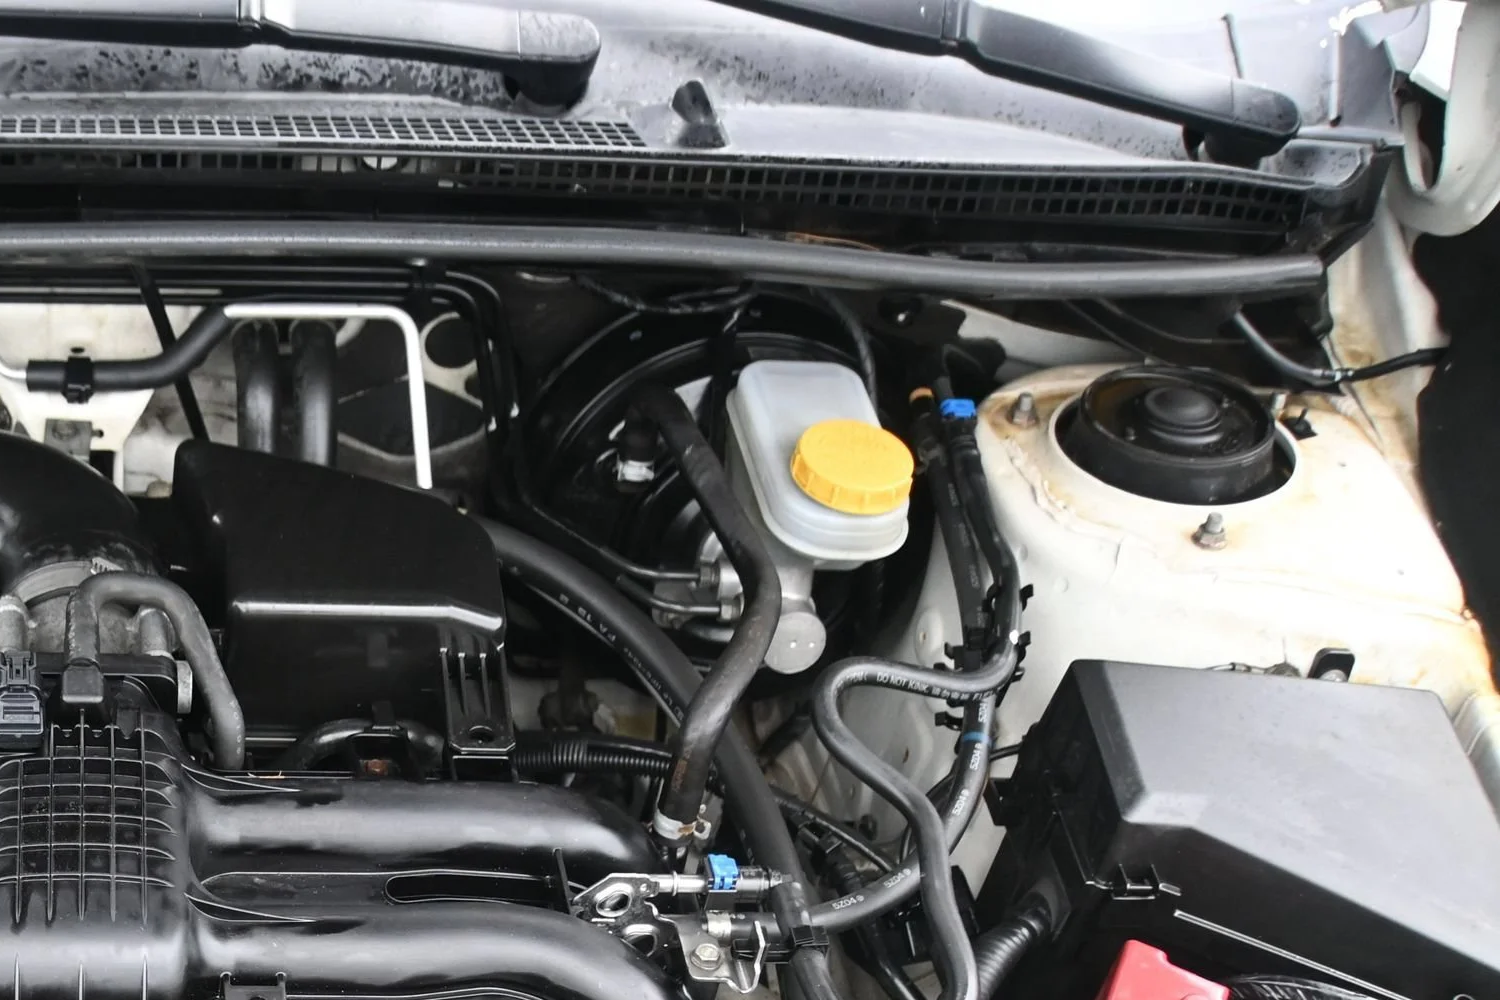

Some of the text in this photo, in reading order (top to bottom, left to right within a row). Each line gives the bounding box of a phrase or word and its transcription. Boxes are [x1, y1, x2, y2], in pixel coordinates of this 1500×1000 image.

[876, 672, 889, 684] DO
[891, 674, 907, 687] NOT
[908, 680, 929, 693] KINK
